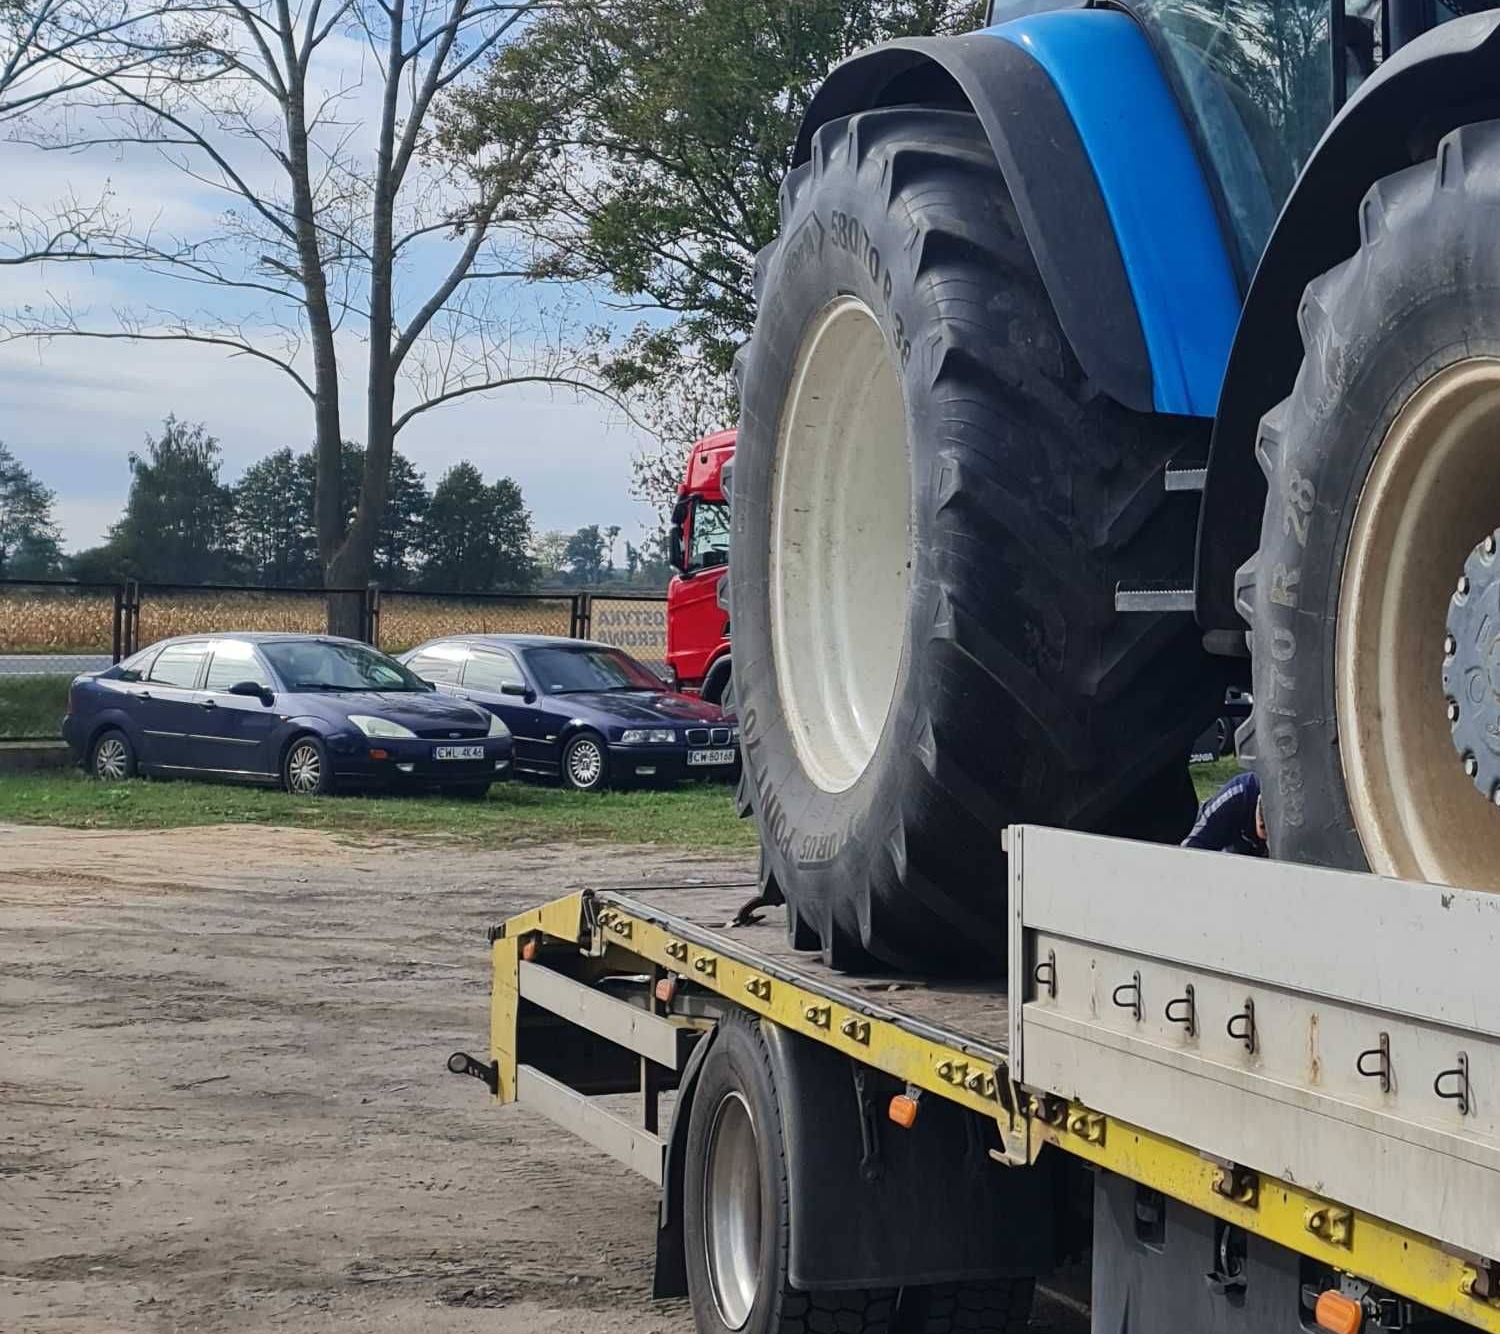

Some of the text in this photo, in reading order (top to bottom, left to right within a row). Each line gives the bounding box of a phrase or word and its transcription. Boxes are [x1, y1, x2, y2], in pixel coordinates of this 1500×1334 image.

[831, 210, 880, 283] 580/70
[1283, 470, 1317, 548] 28
[1270, 562, 1298, 609] R
[693, 751, 707, 763] CW
